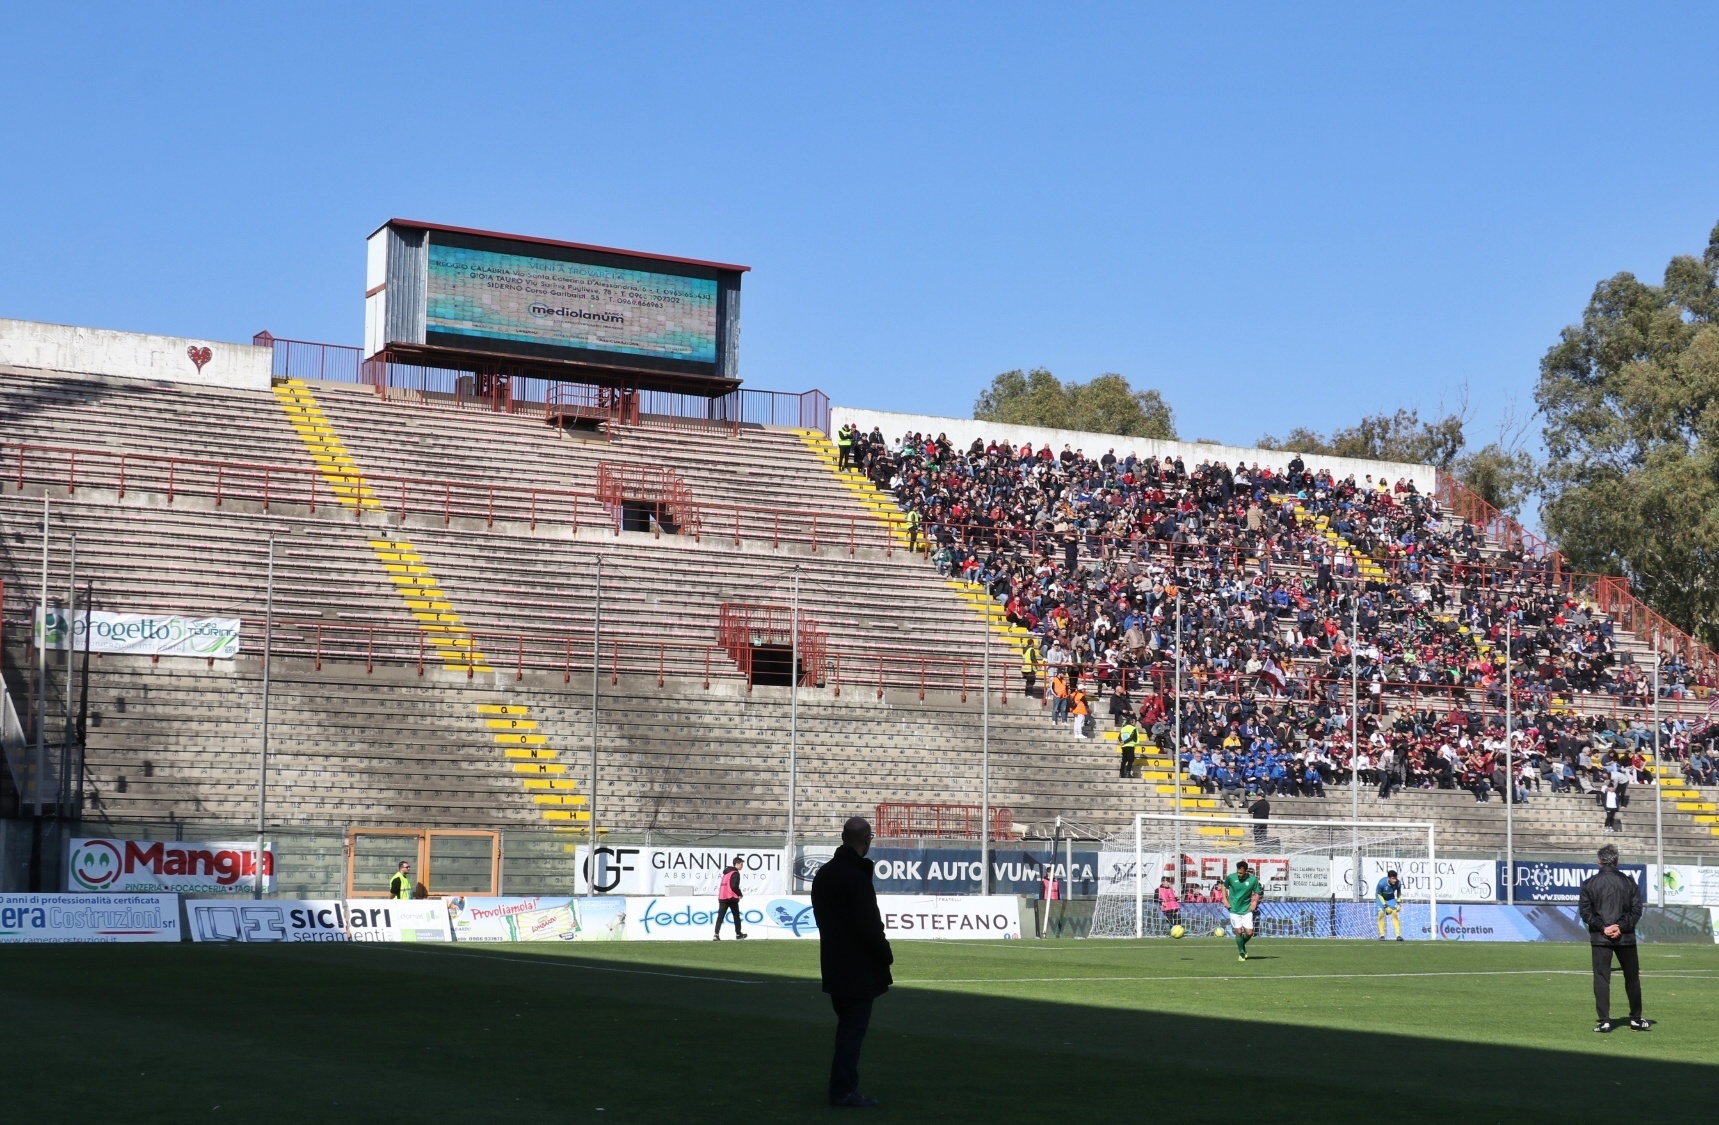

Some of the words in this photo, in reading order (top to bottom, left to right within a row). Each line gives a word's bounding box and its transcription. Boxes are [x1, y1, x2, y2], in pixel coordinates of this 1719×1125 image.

[436, 260, 468, 270] REGGIO
[470, 265, 510, 275] CALABRIA
[470, 273, 493, 281] GIOIA
[496, 275, 523, 284] TAURO
[487, 282, 523, 291] SIDERNO
[525, 286, 548, 295] Corso
[532, 304, 624, 324] mediolanum
[511, 720, 516, 728] P
[531, 750, 537, 758] N
[124, 840, 275, 886] Mangia
[652, 851, 728, 870] GIANNI
[736, 853, 780, 871] OTI
[1375, 861, 1404, 873] NEW
[664, 872, 766, 880] ABBIGLIANTO
[873, 859, 922, 881] ORK
[927, 861, 983, 882] AUTO
[125, 883, 163, 892] PINZERIA
[170, 884, 227, 893] FOCACCERIA
[1399, 876, 1443, 890] APUTO
[6, 896, 28, 904] anni
[30, 896, 39, 904] di
[41, 896, 112, 906] professionalità
[114, 896, 160, 904] certificata
[50, 907, 162, 928] Costruzioni
[163, 919, 176, 928] srl
[290, 903, 392, 929] siclari
[639, 899, 764, 934] federco
[885, 913, 1008, 930] ESTEFANO
[1445, 925, 1493, 935] decoration
